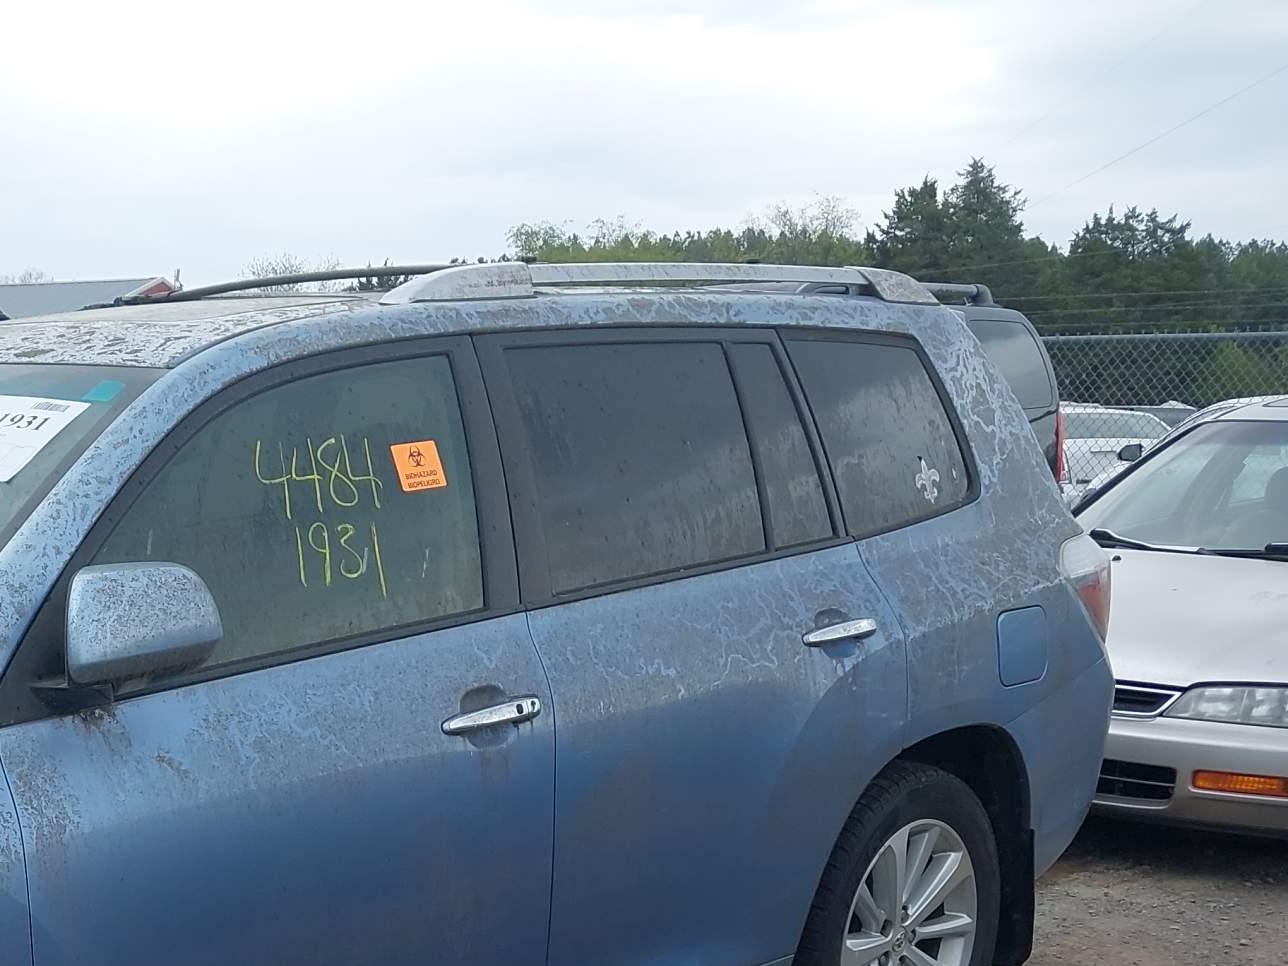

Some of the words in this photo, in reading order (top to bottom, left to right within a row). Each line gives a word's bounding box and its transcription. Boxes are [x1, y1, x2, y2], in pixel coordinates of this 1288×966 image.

[255, 433, 383, 520] 4484
[404, 469, 438, 480] BIOHAZARD
[407, 479, 441, 489] BIOPELIGRO
[295, 521, 387, 598] 1931
